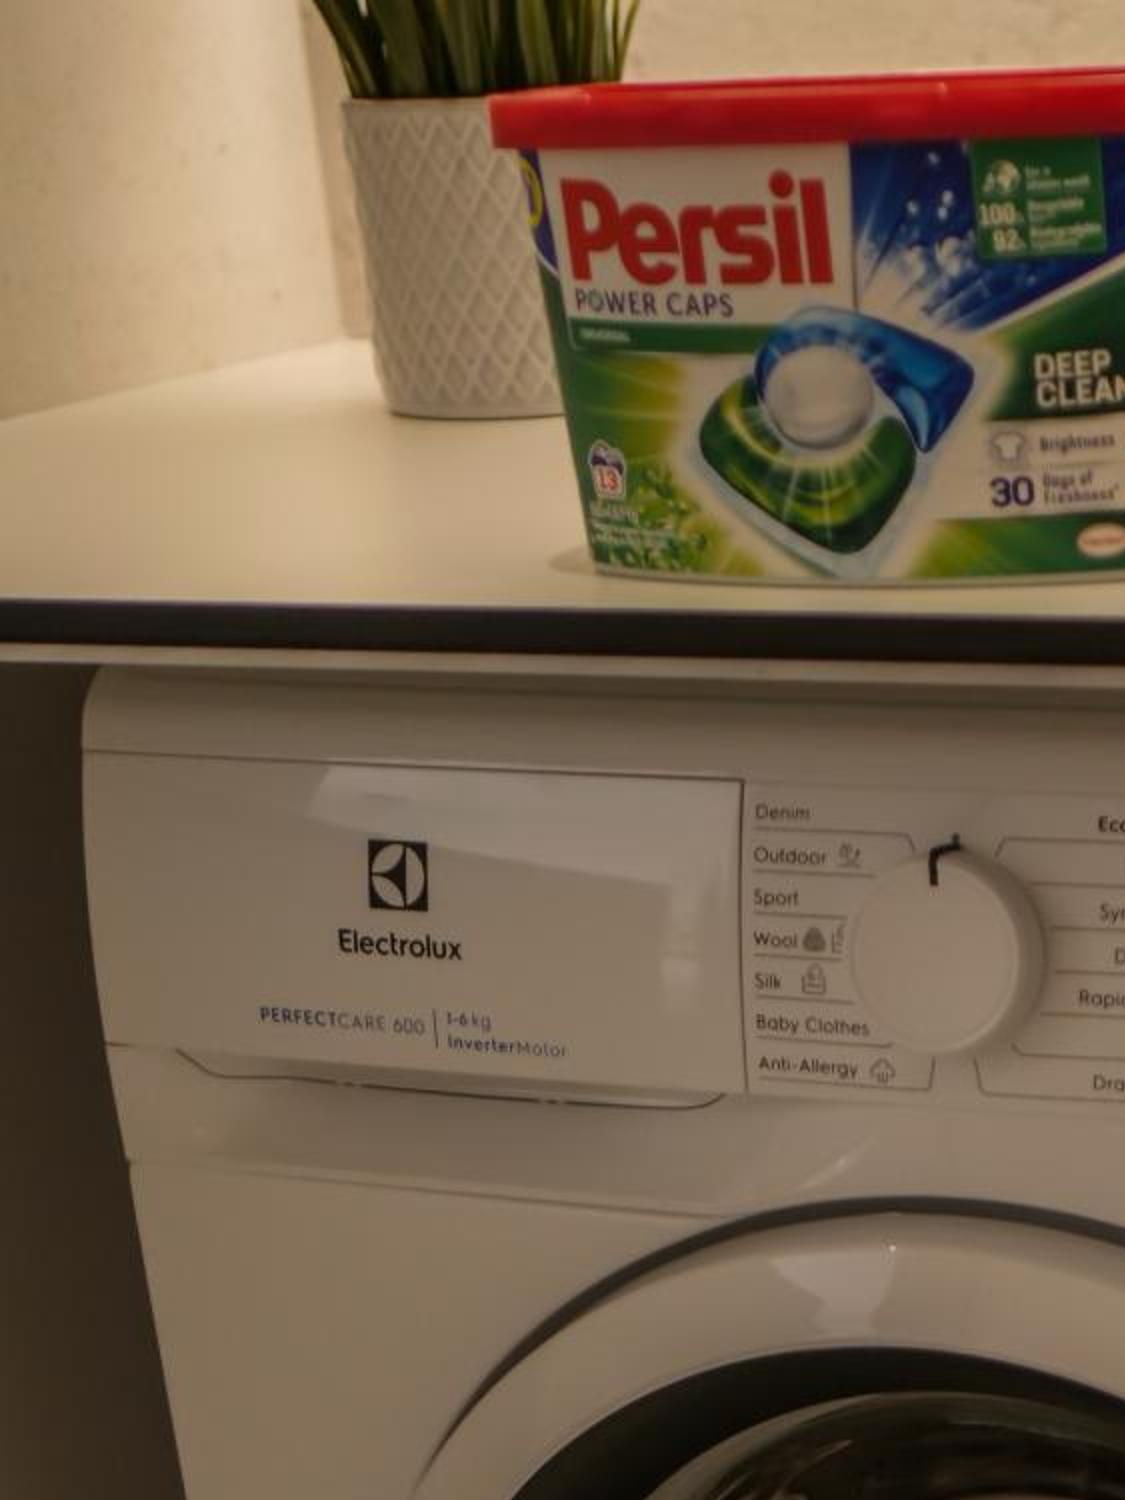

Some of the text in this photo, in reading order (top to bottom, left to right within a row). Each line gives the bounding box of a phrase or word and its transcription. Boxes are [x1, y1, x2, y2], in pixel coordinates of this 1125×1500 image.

[560, 170, 834, 285] Persil
[575, 288, 735, 318] POWER CAPS
[1034, 349, 1112, 380] DEEP
[1040, 432, 1116, 454] Brightness
[990, 476, 1035, 508] 30
[755, 804, 811, 821] Denim
[754, 846, 826, 865] Outdoor
[754, 889, 800, 908] Sport
[337, 928, 463, 961] Electrolux
[753, 931, 798, 949] Wool
[754, 973, 782, 990] Silk
[260, 1006, 426, 1037] PERFECTCARE 600
[470, 1012, 492, 1033] kg
[755, 1013, 870, 1037] Baby Clothes
[447, 1034, 569, 1059] InverterMotor
[758, 1056, 859, 1080] Anti-Allergy
